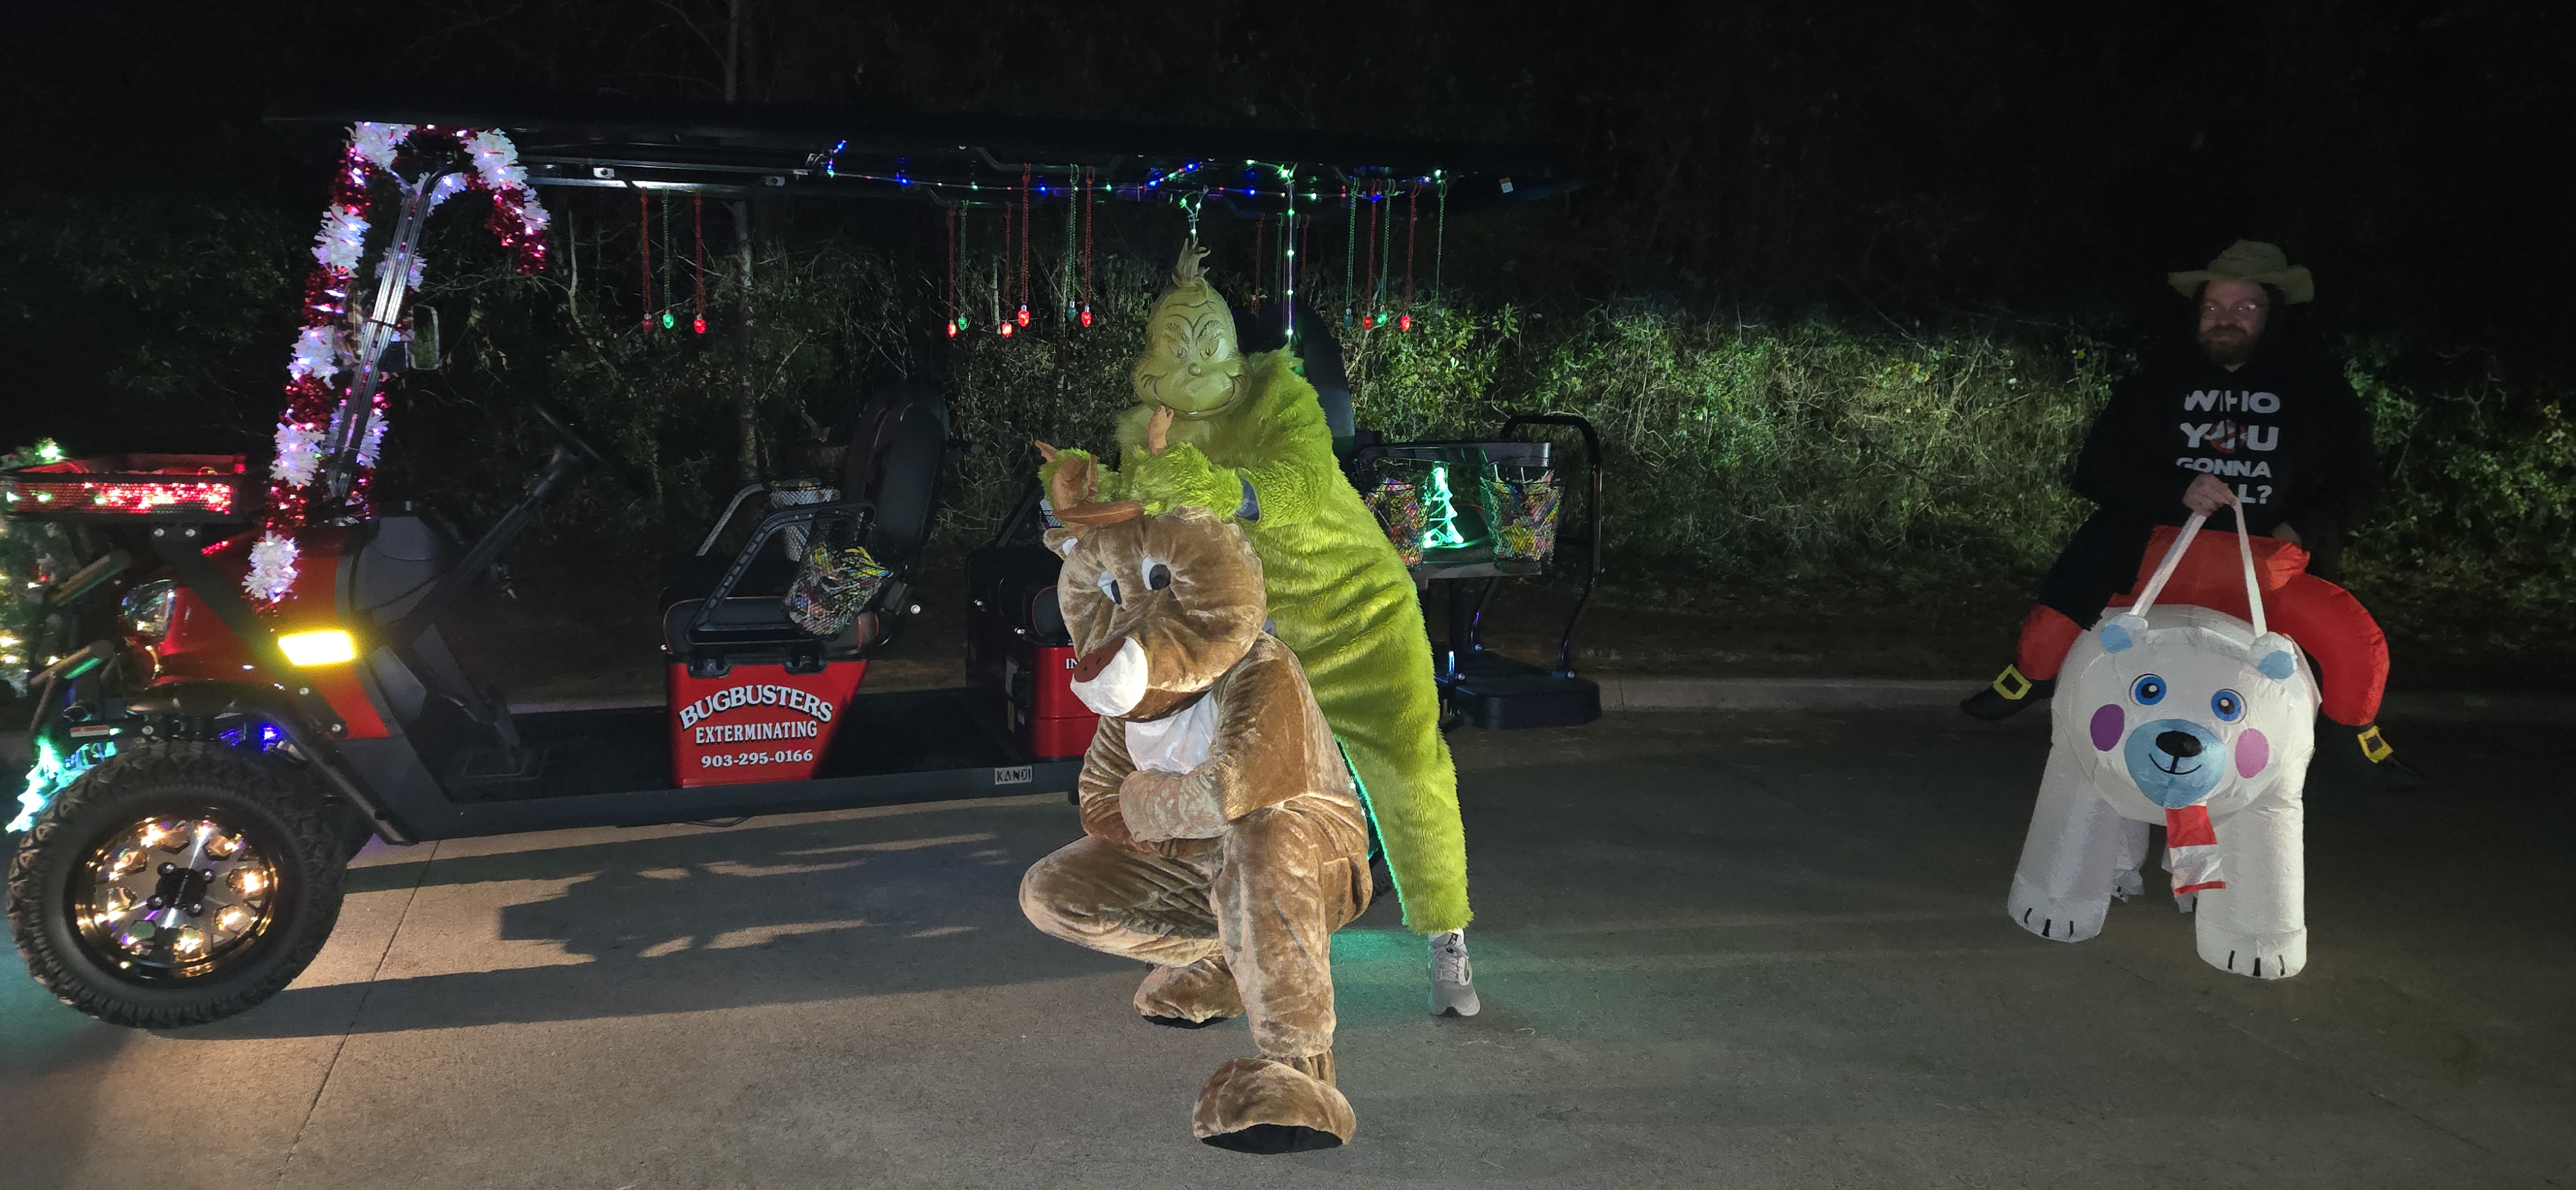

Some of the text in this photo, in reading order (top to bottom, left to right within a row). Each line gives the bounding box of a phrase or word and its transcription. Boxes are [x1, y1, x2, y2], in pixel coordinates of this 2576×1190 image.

[2184, 389, 2281, 414] WHO
[2175, 457, 2273, 478] GONNA
[679, 684, 833, 730] BUGBUSTERS
[695, 720, 818, 744] EXTERMINATING
[701, 749, 813, 768] 903-295-0166
[996, 768, 1031, 782] KANDI
